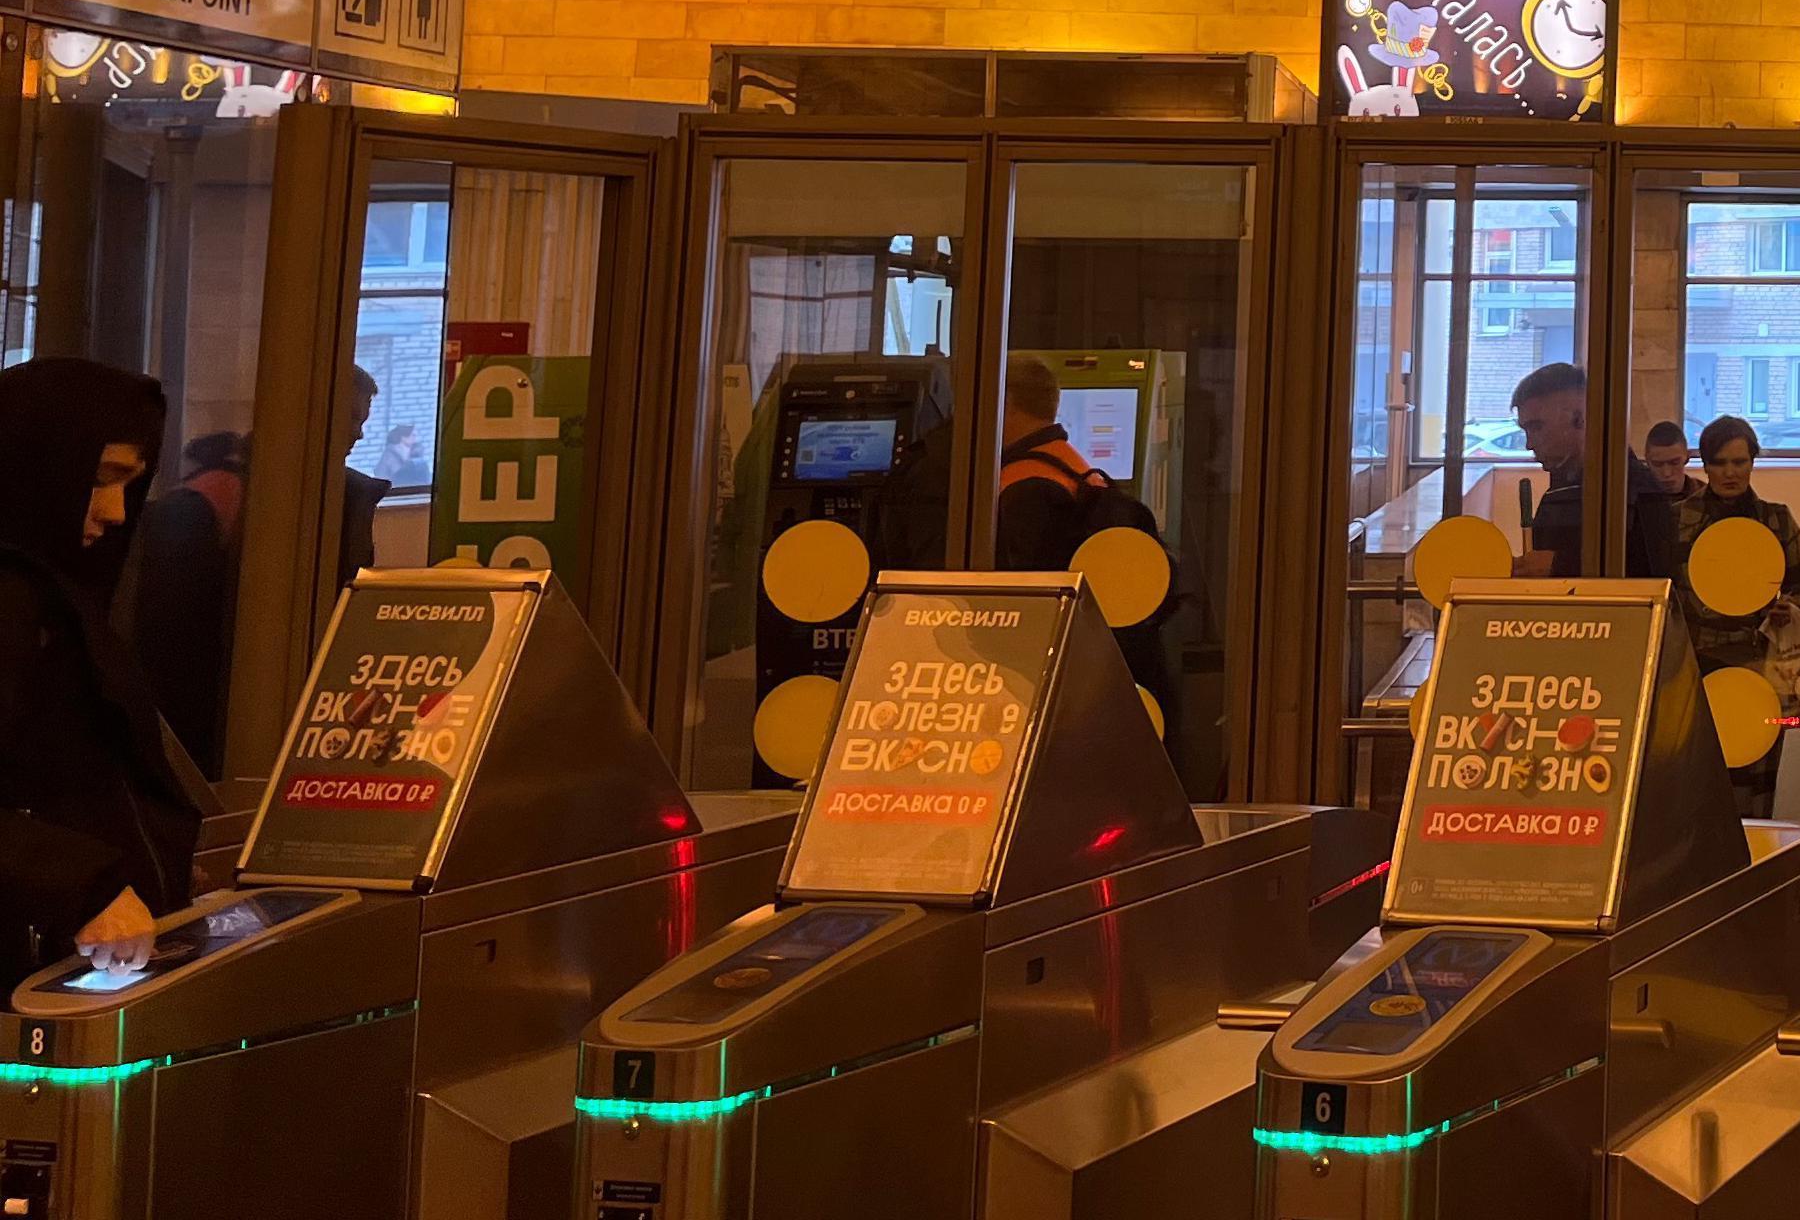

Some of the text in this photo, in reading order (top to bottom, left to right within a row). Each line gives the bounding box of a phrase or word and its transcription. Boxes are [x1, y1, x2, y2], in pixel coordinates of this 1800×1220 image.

[376, 604, 485, 622] ВКУСВИЛЛ
[904, 609, 1021, 628] ВКУСВИЛЛ
[1486, 620, 1611, 639] ВКУСВИЛЛ
[31, 1027, 45, 1055] 8
[627, 1059, 643, 1090] 7
[1315, 1092, 1331, 1123] 6
